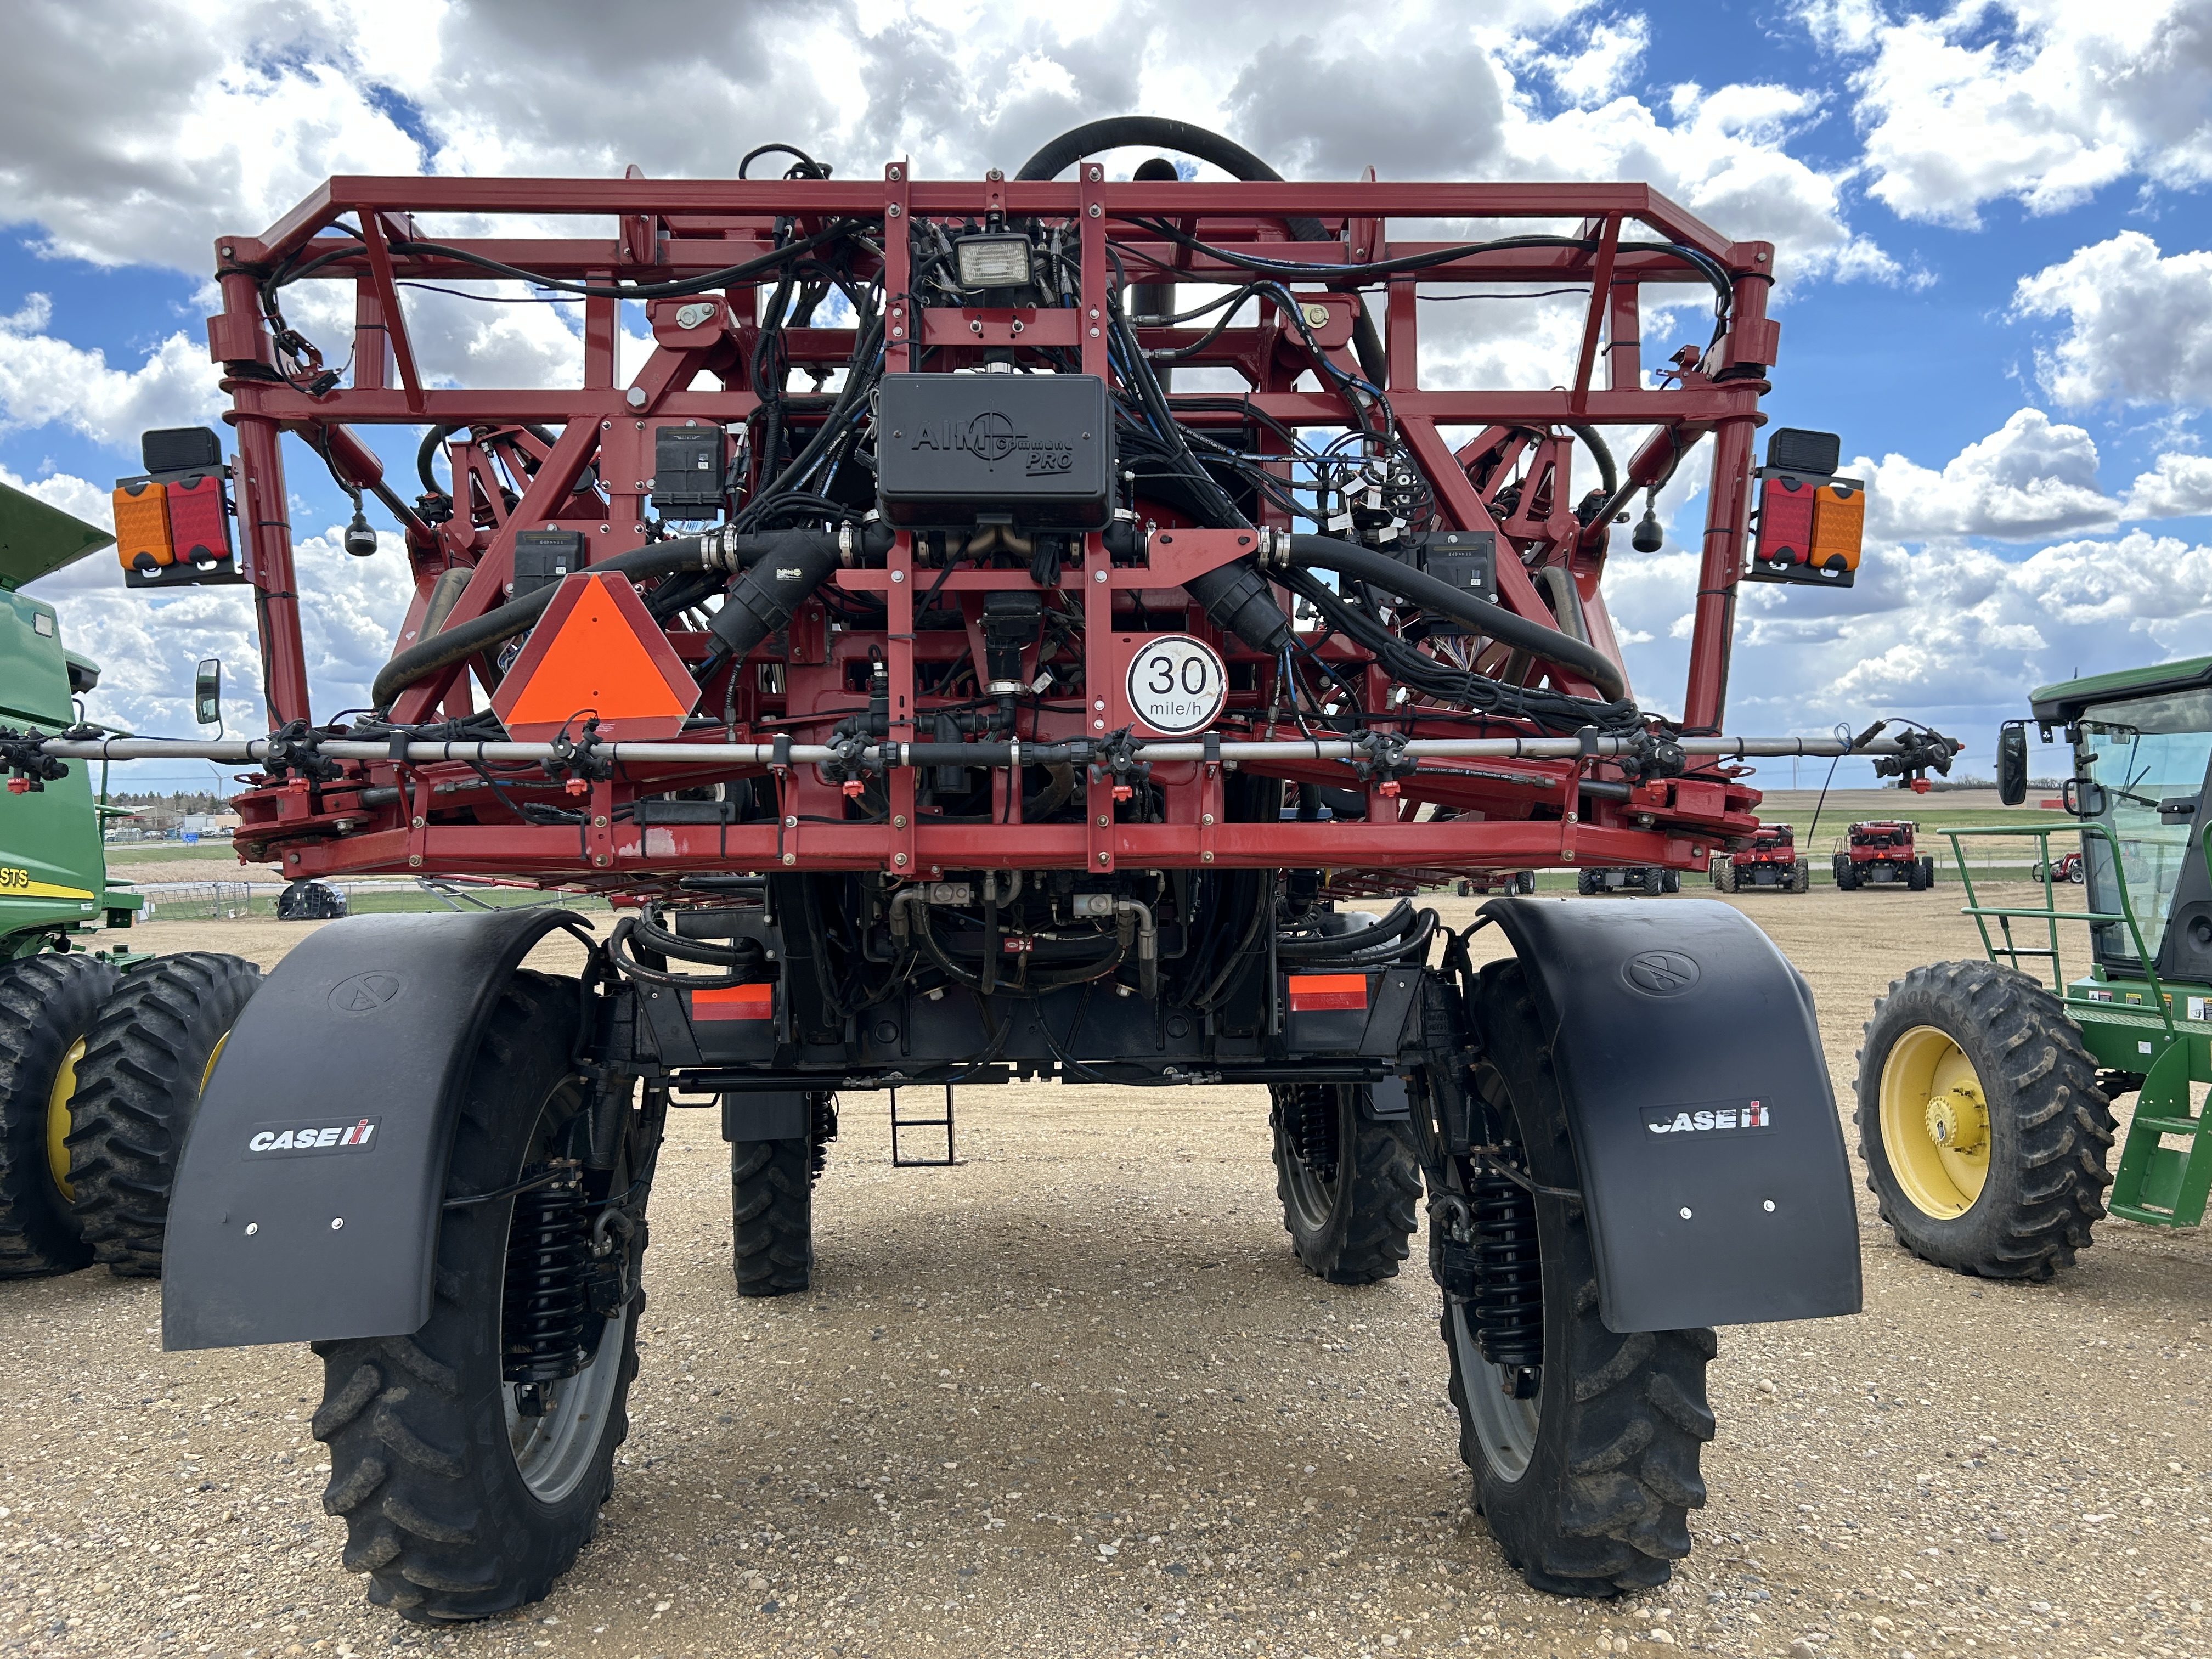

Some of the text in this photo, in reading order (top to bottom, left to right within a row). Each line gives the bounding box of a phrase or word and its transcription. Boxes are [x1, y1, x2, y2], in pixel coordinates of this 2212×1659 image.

[911, 419, 987, 450] AIM
[1025, 452, 1074, 470] PRO
[1148, 656, 1207, 695] 30
[1150, 701, 1202, 717] mile/h
[249, 1128, 340, 1152] CASE
